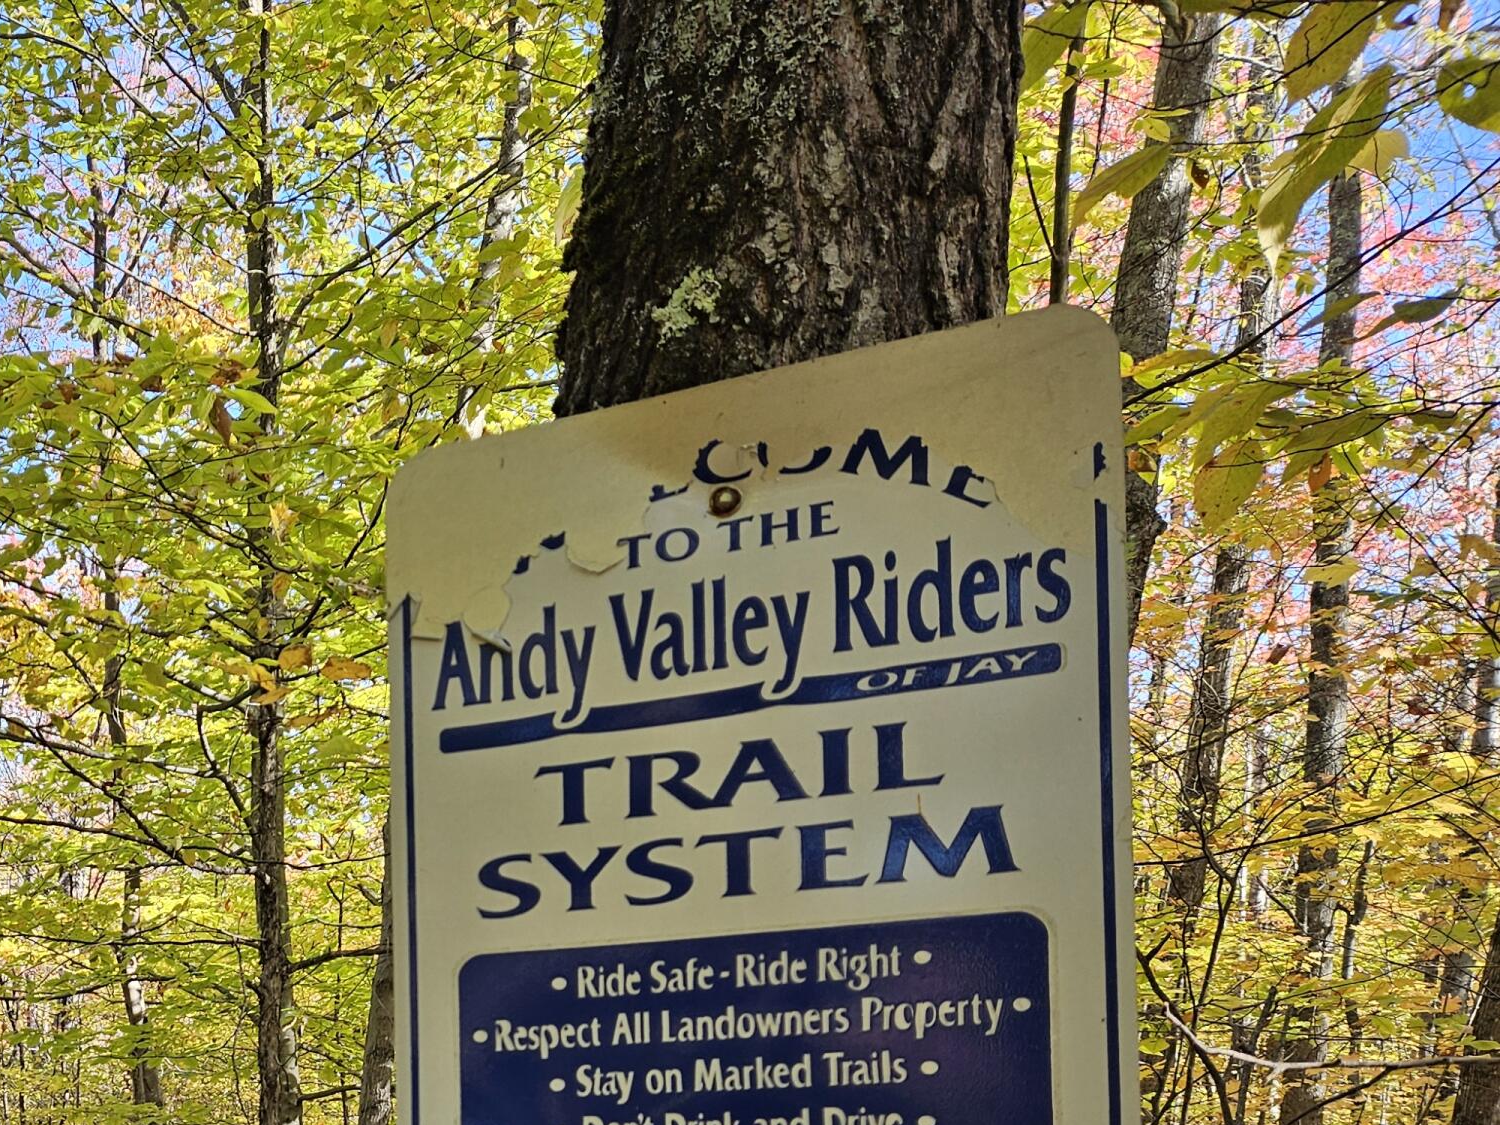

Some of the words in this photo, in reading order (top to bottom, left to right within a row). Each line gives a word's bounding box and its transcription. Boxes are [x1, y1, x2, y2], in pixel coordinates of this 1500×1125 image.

[617, 527, 700, 570] TO
[717, 500, 840, 552] THE
[431, 603, 596, 724] Andy
[609, 574, 810, 694] Valley
[832, 535, 1071, 653] Riders
[856, 667, 934, 692] OF
[942, 649, 1038, 688] JAY
[534, 721, 945, 826] TRAIL
[477, 804, 1021, 919] SYSTEM
[576, 964, 641, 998] Ride
[816, 943, 902, 990] Right
[494, 1013, 601, 1059] Respect
[612, 1010, 651, 1045] All
[661, 1003, 849, 1042] Landowners
[860, 995, 1004, 1038] Property
[575, 1064, 633, 1104] Stay
[645, 1069, 682, 1093] on
[694, 1053, 812, 1093] Marked
[822, 1049, 908, 1085] Trails
